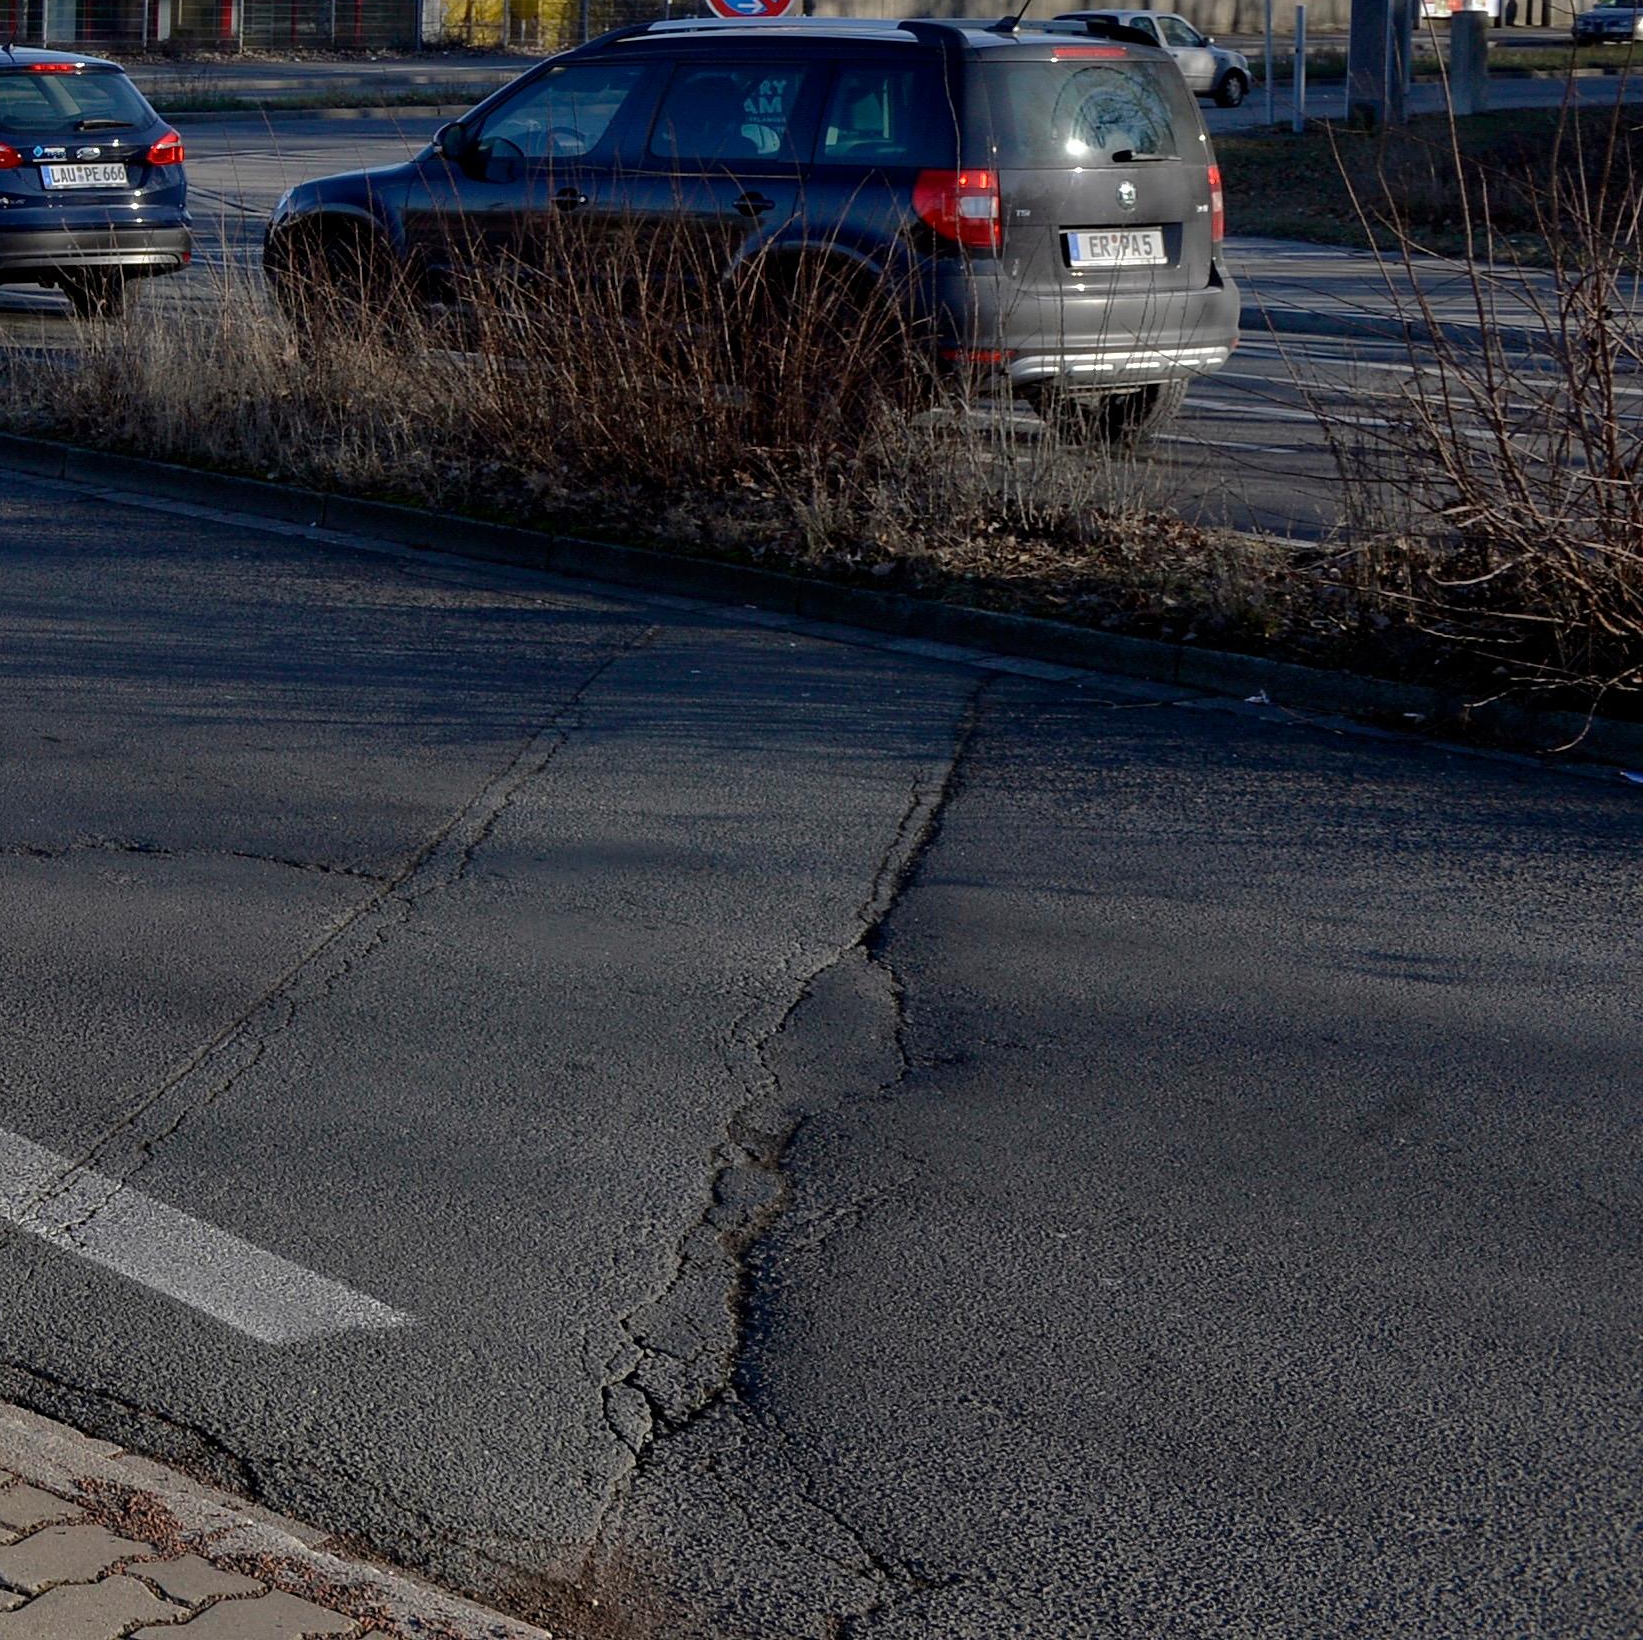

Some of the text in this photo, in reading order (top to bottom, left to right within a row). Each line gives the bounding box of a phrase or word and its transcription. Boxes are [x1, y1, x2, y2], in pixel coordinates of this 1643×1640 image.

[51, 165, 125, 183] LAU PE 666
[1089, 235, 1111, 258] ER
